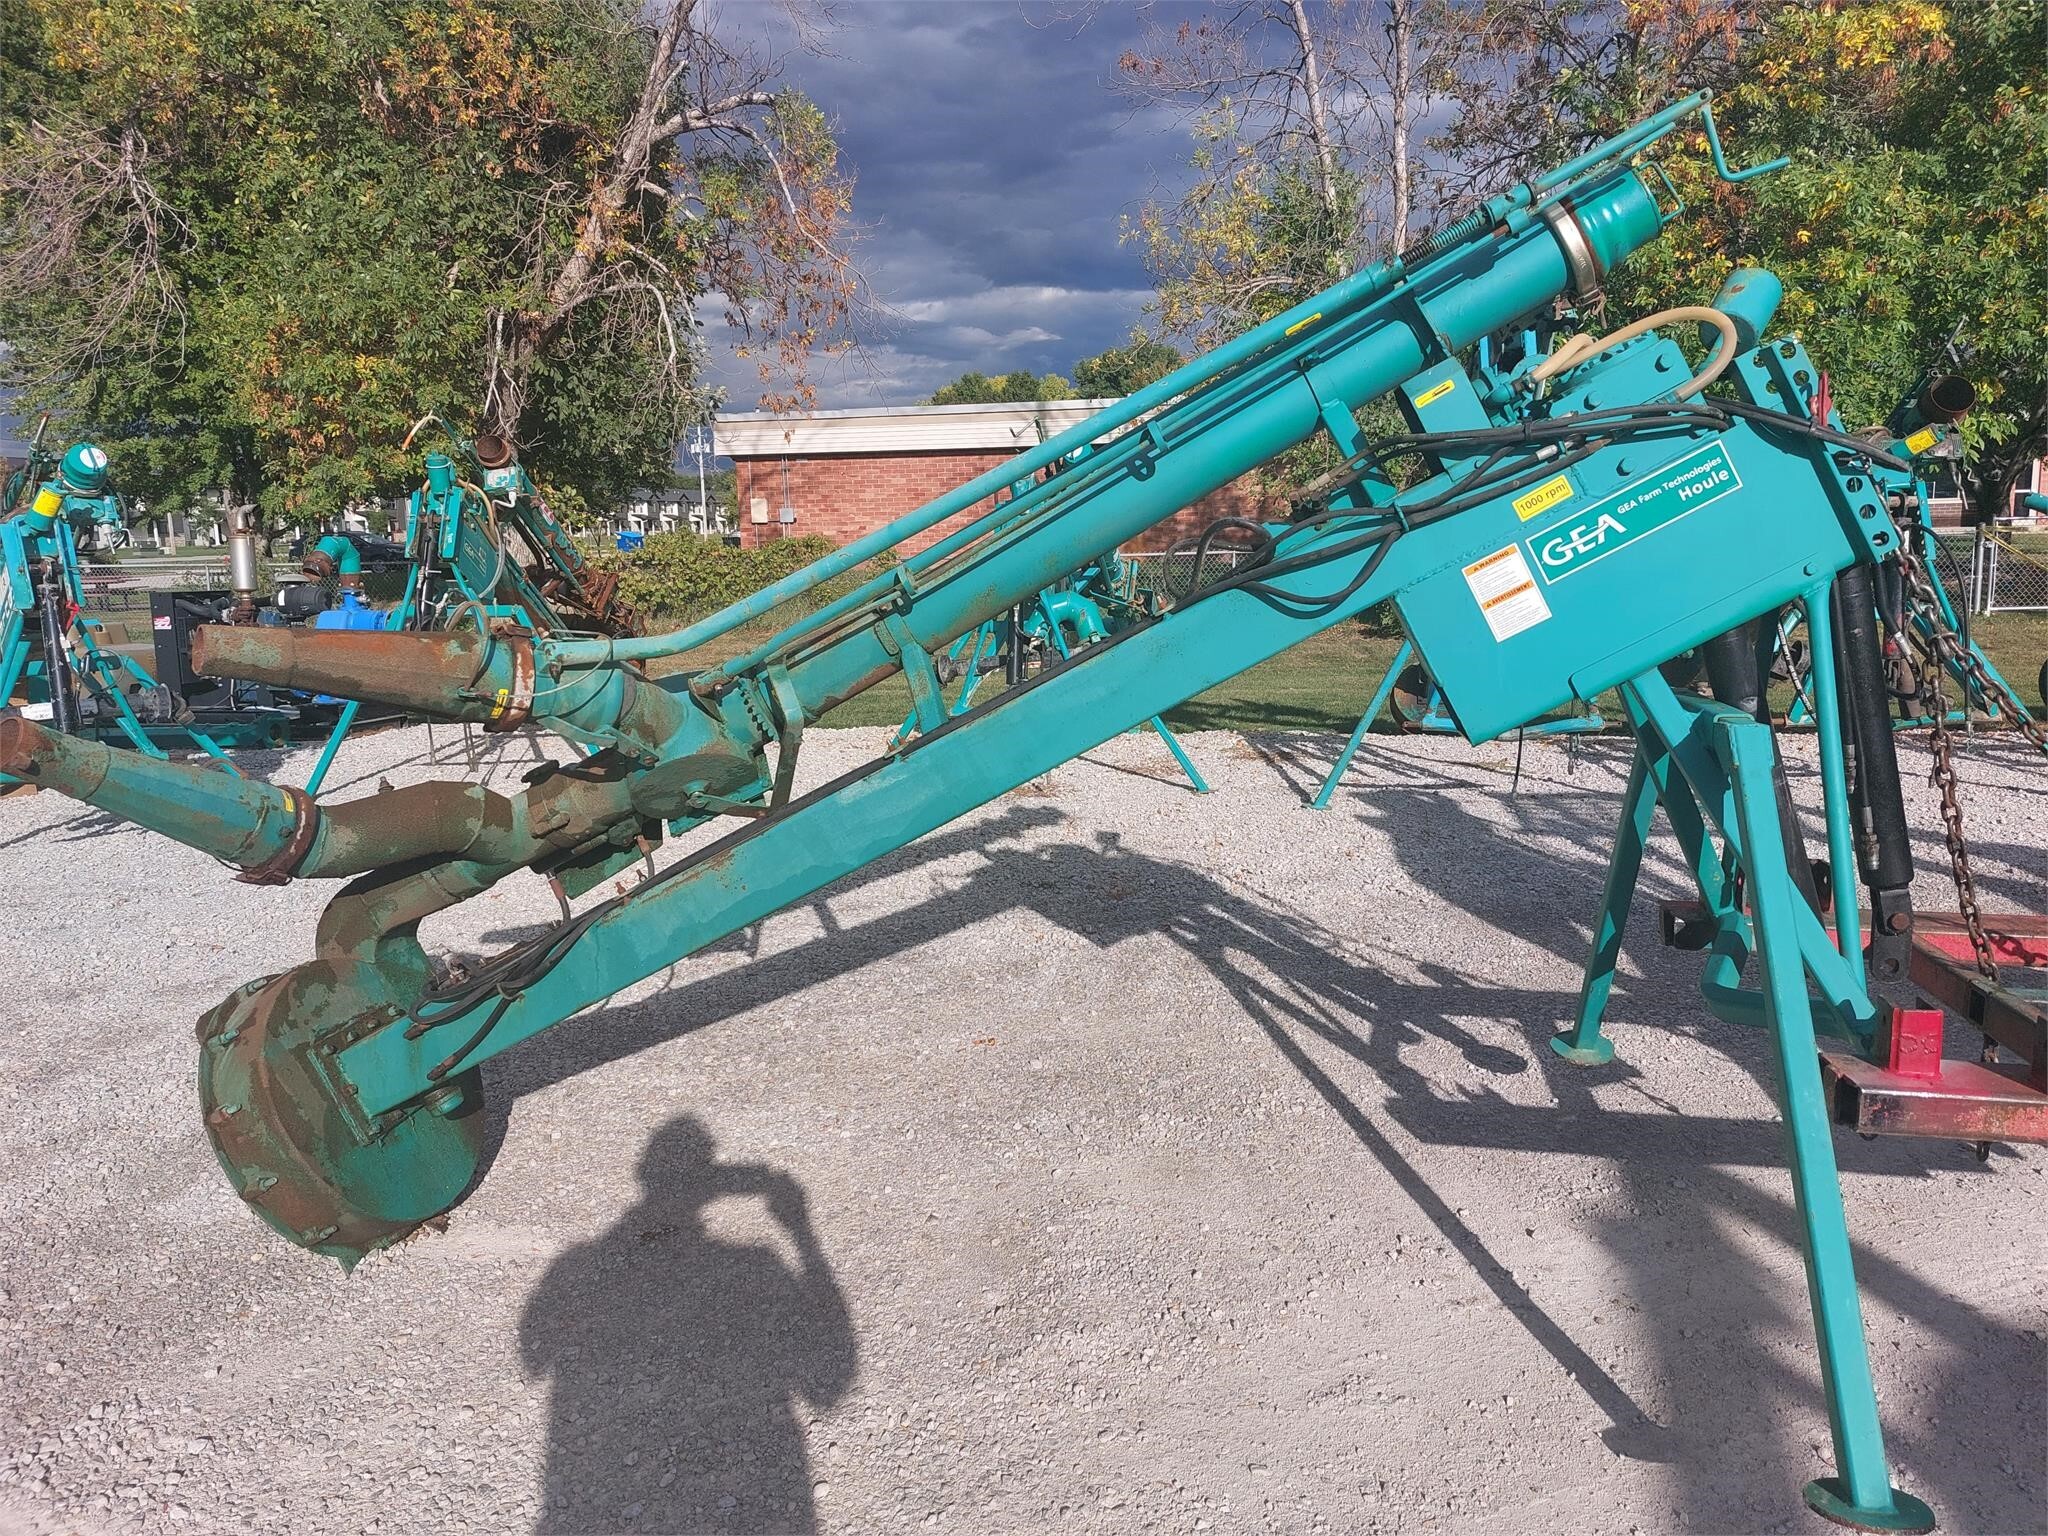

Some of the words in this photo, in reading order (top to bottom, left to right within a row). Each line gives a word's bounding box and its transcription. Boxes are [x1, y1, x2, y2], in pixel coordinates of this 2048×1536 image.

[1520, 494, 1544, 512] 1000
[1546, 483, 1566, 503] rpm
[1617, 500, 1638, 515] GEA
[1638, 488, 1662, 504] Farm
[1662, 456, 1722, 492] Technologies
[1677, 469, 1730, 502] Houle
[1541, 513, 1628, 566] GEA
[1479, 550, 1510, 569] WARNING
